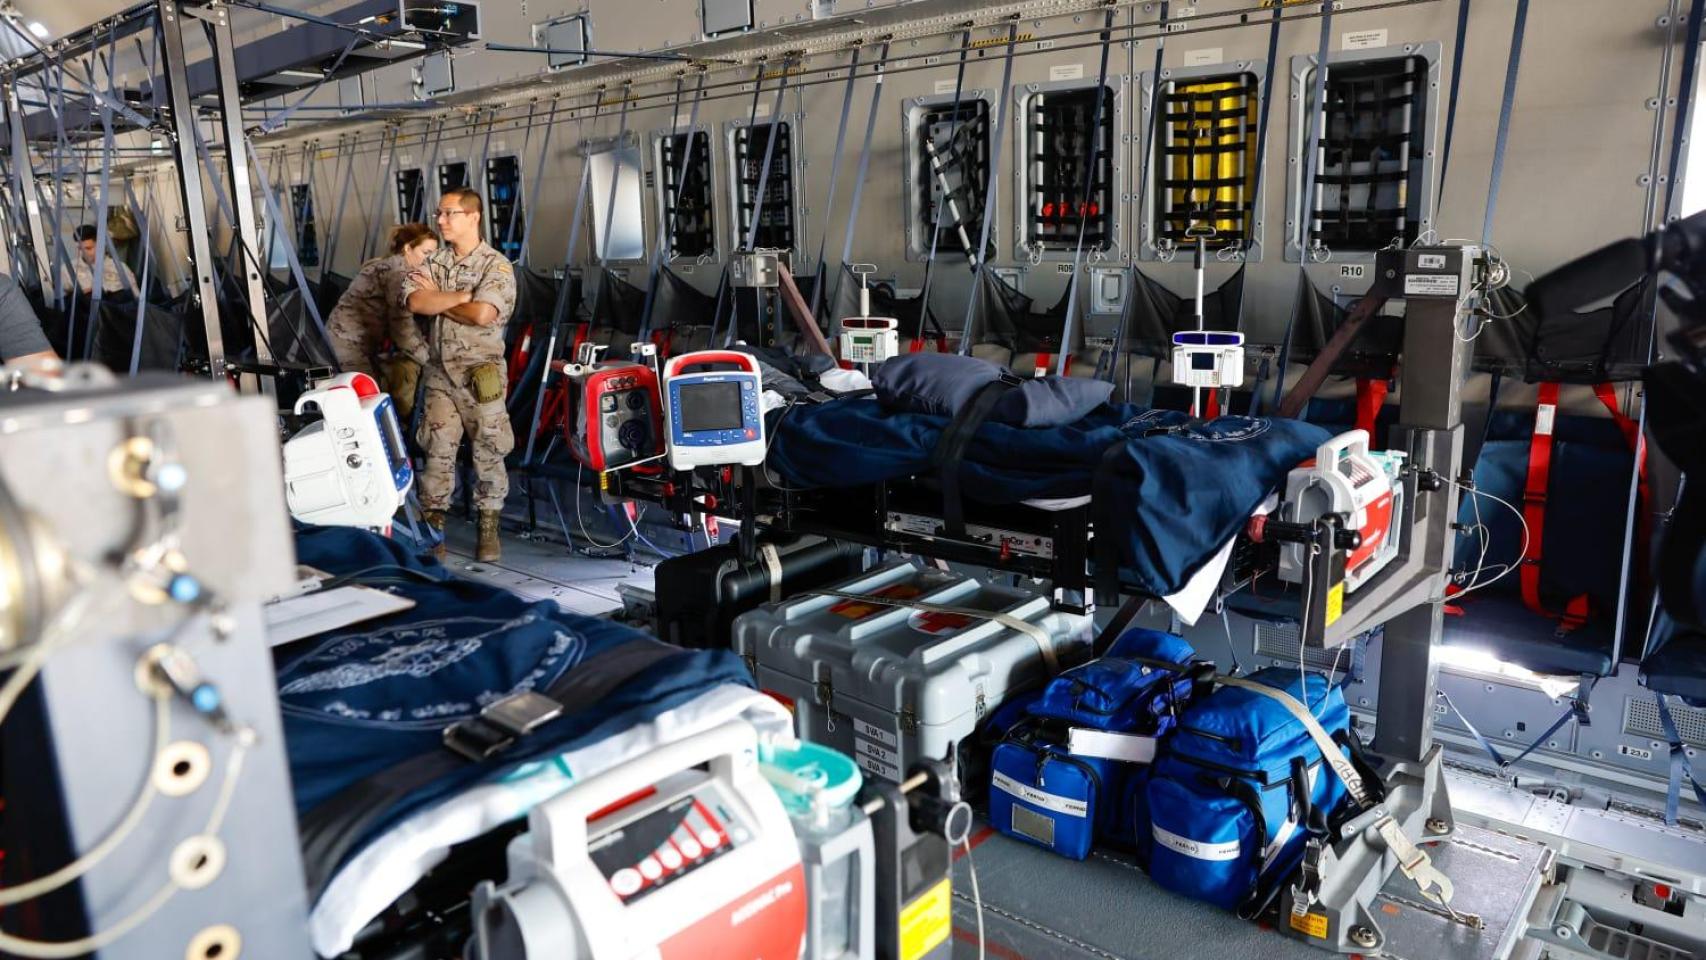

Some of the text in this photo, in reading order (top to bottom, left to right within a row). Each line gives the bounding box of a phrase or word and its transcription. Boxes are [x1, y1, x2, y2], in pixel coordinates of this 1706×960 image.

[1057, 264, 1073, 273] R09
[1341, 265, 1362, 276] R10
[881, 750, 887, 760] 2
